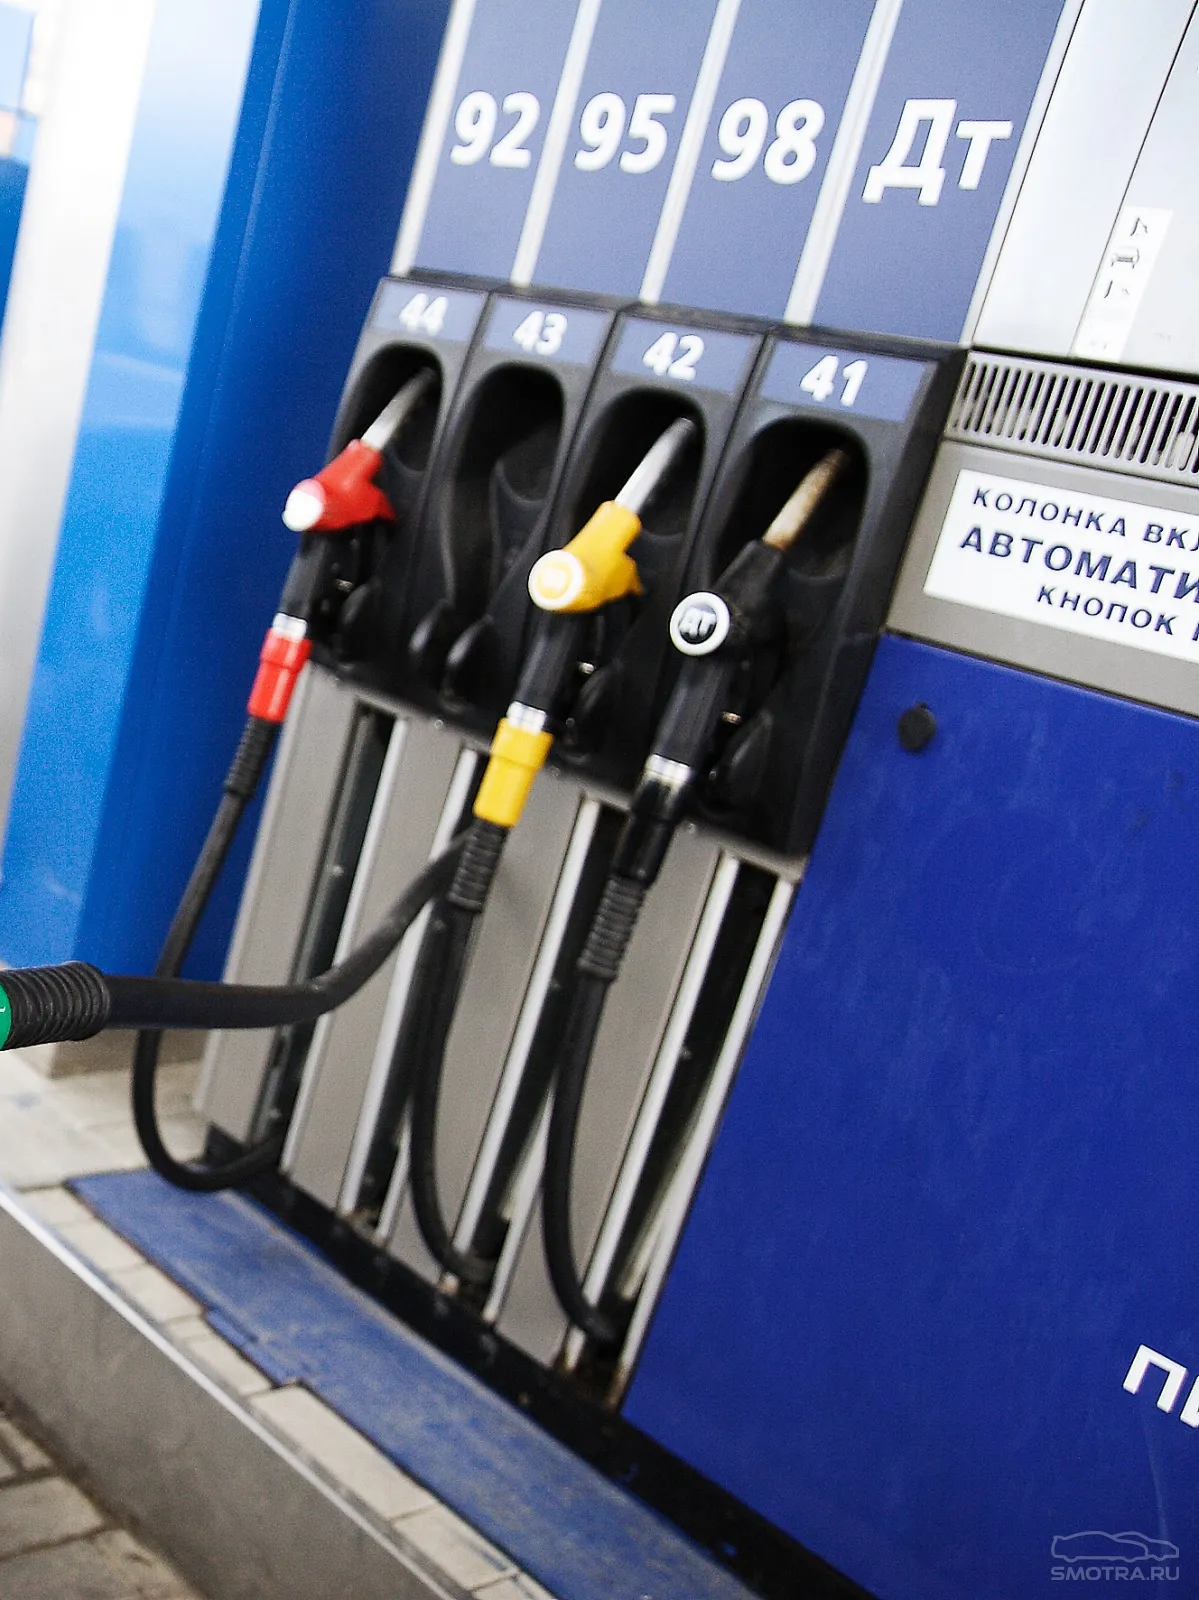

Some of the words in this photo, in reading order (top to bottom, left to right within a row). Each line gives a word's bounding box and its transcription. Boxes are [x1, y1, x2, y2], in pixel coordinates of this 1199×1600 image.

[450, 91, 539, 169] 92
[574, 92, 676, 174] 95
[711, 98, 825, 184] 98
[399, 293, 448, 336] 44
[512, 311, 567, 355] 43
[642, 332, 704, 381] 42
[800, 354, 868, 407] 41
[973, 487, 1127, 537] КОЛОНКА
[960, 527, 1199, 604] АВТОМАТИ
[1037, 585, 1180, 636] КНОПОК
